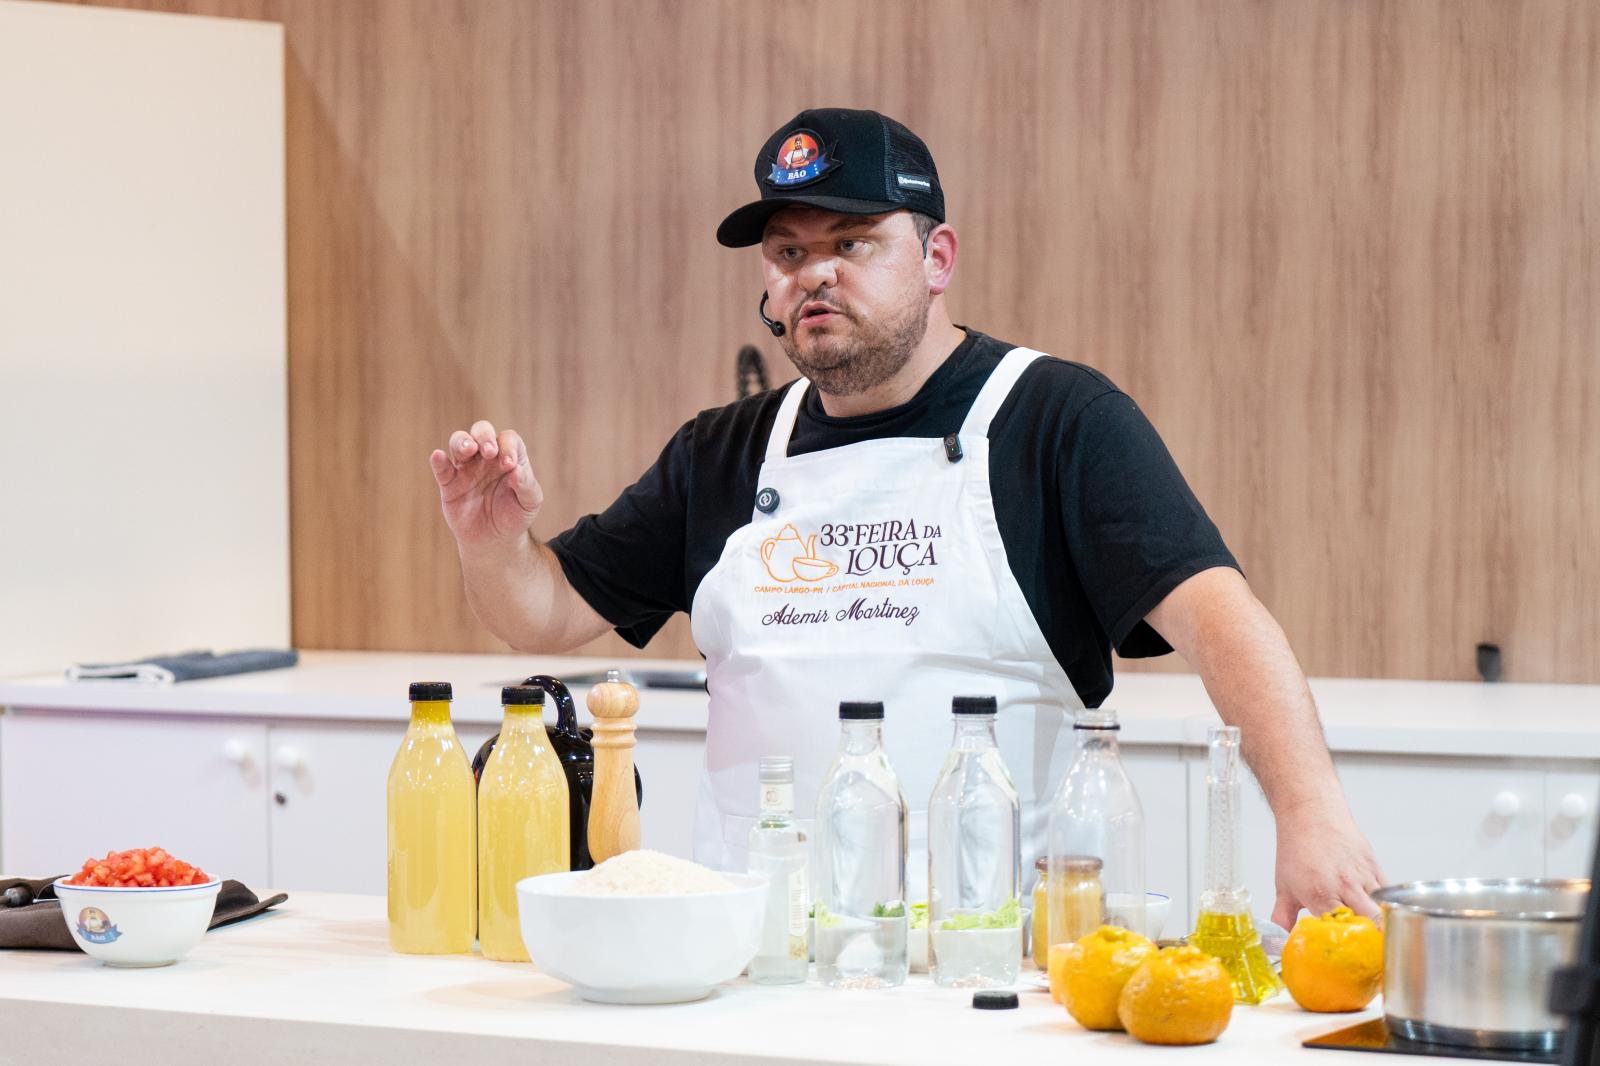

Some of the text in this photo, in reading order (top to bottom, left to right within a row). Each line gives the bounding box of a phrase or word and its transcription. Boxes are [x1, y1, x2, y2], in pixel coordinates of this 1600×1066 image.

[855, 518, 918, 546] FEIRA
[922, 525, 942, 539] DA
[845, 541, 938, 576] LOUÇA
[754, 585, 783, 593] CAMPO
[831, 583, 859, 592] CAPITAL
[859, 580, 897, 589] NACIONAL
[898, 579, 910, 587] DA
[911, 577, 935, 587] LOUÇA
[761, 597, 920, 626] Ademir Martinez
